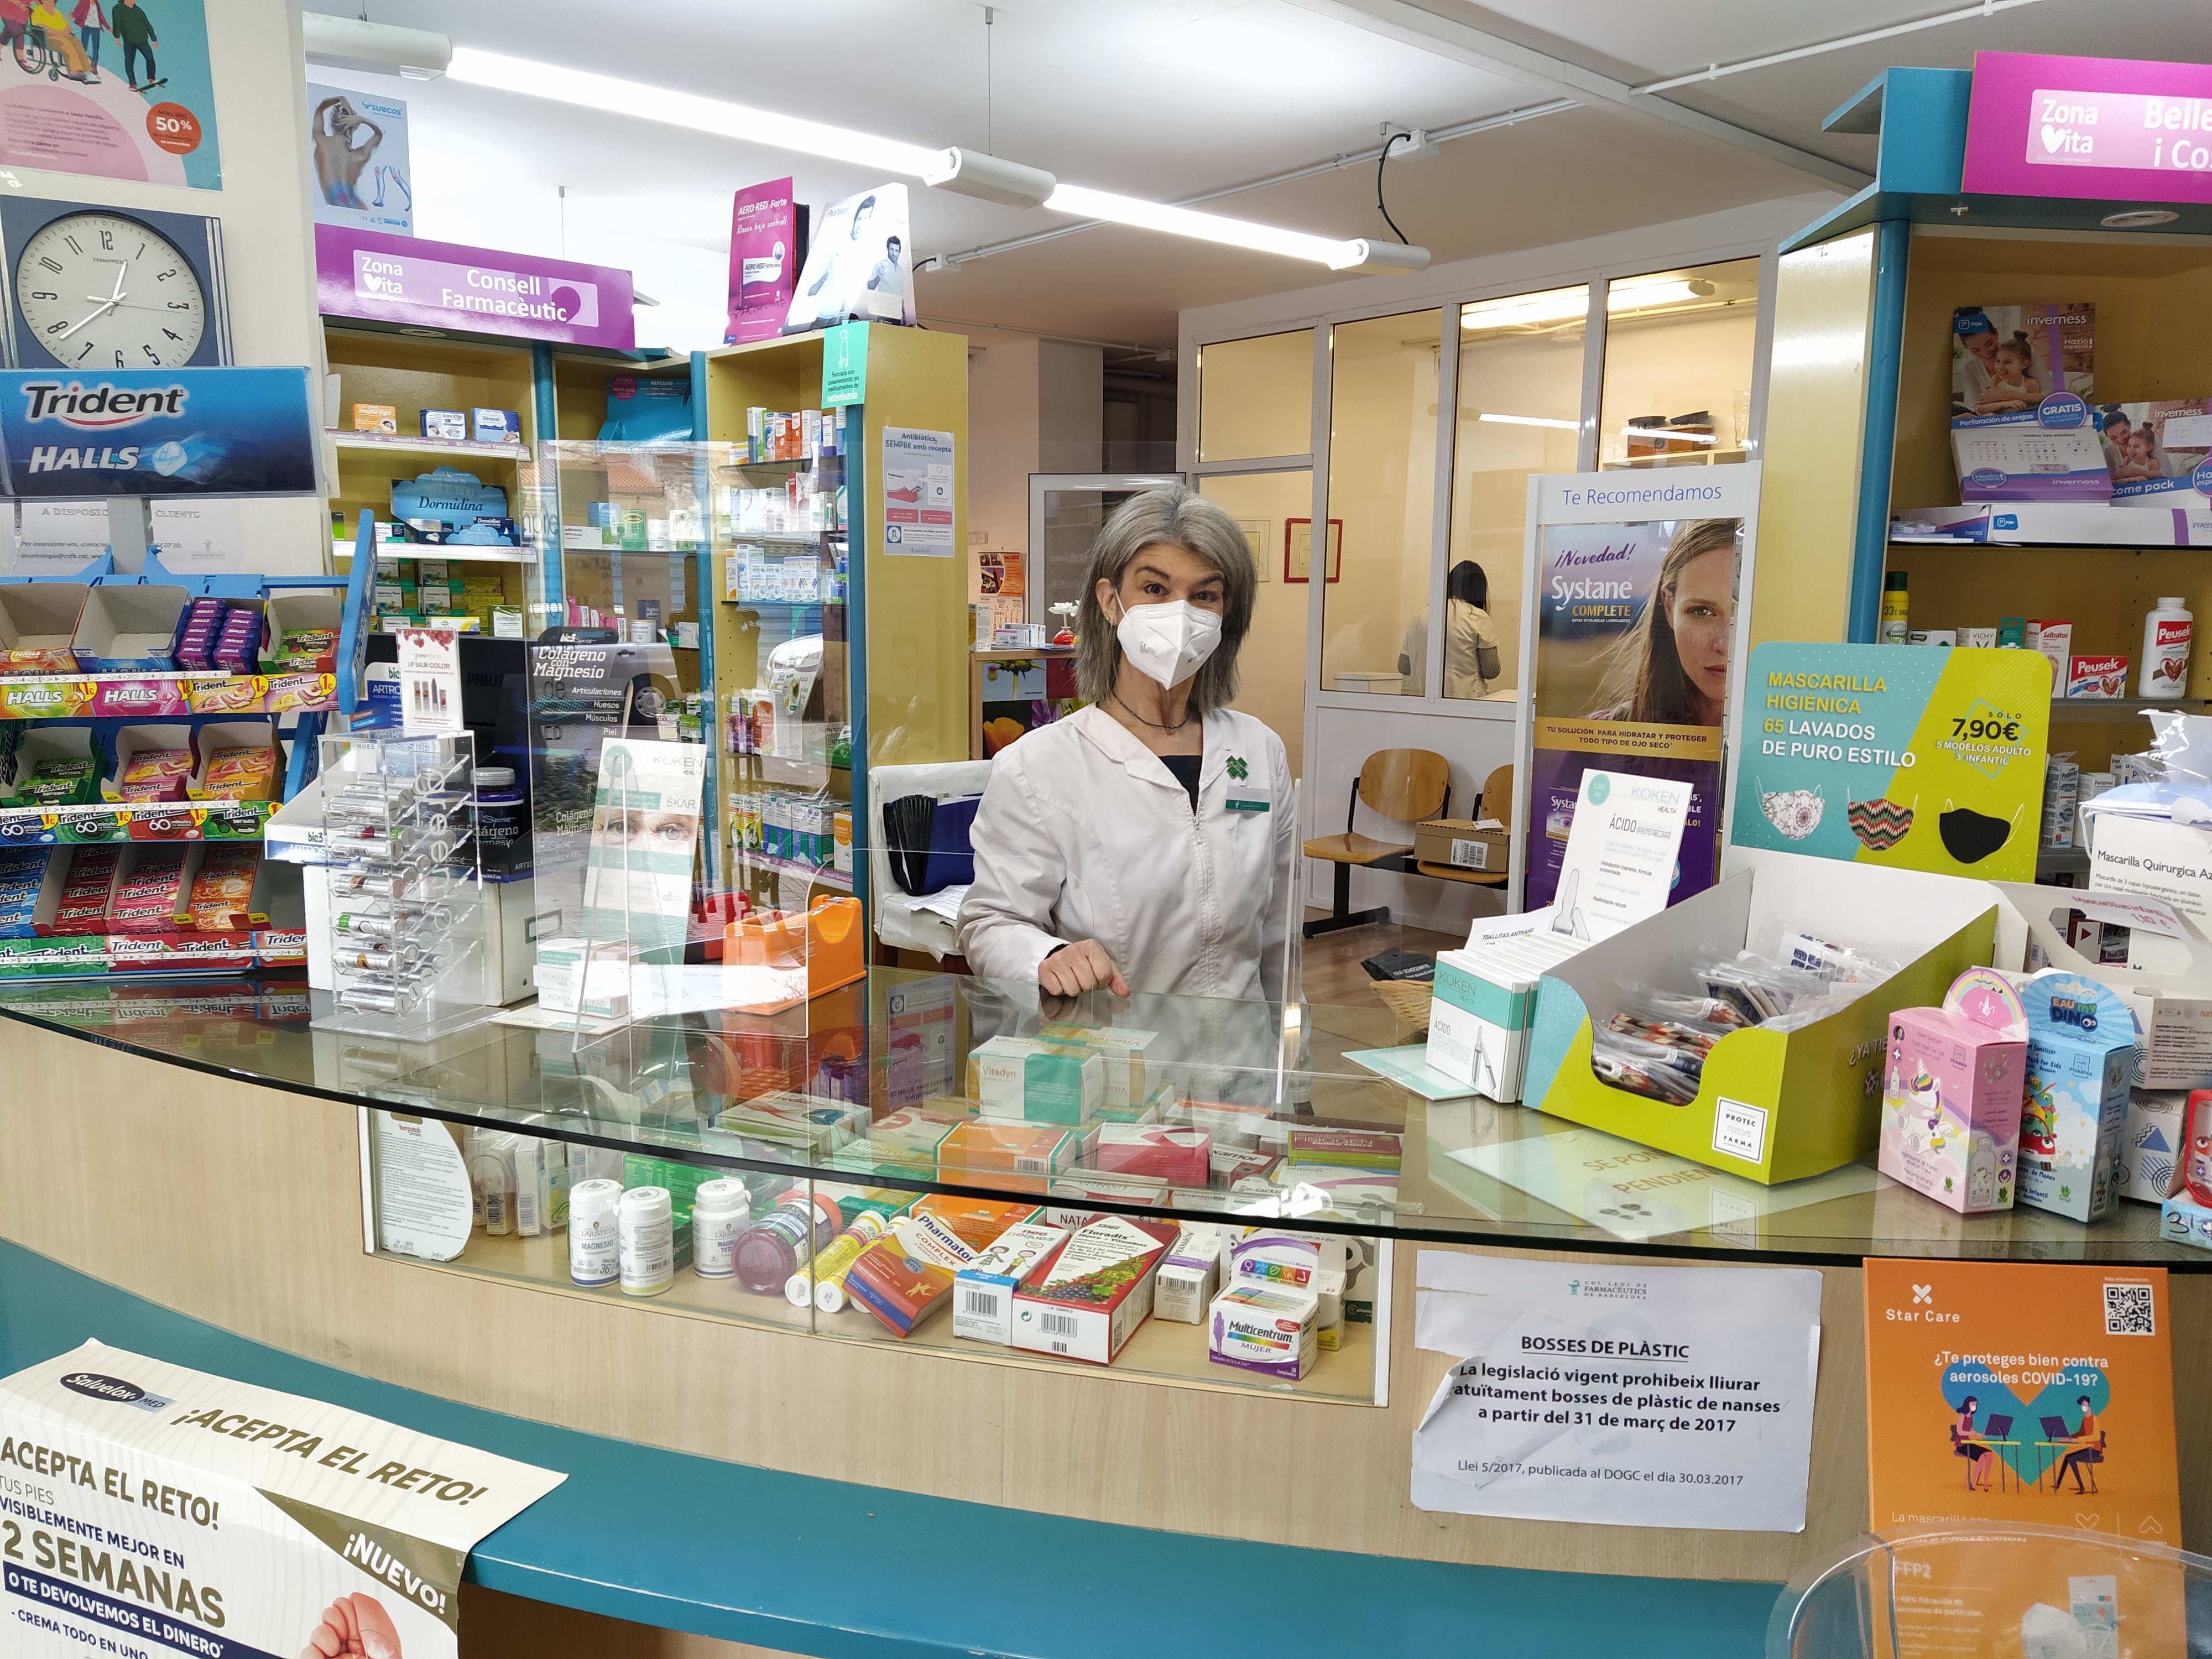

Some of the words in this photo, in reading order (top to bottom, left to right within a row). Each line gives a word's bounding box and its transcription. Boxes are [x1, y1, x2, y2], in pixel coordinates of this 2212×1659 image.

[371, 103, 401, 116] suecos
[2041, 98, 2098, 126] Zona
[155, 117, 192, 132] 50%
[2154, 138, 2162, 167] i
[770, 197, 787, 208] Forte
[754, 221, 765, 233] bajo
[100, 230, 113, 251] 12
[361, 256, 403, 277] Zona
[156, 269, 176, 281] 2
[467, 269, 541, 296] Consell
[442, 288, 567, 322] Farmacèutic
[2027, 314, 2087, 326] inverness
[162, 328, 183, 341] 4
[827, 376, 853, 385] asesoramiento
[827, 383, 851, 392] medicamentos
[25, 385, 184, 418] Trident
[827, 390, 858, 403] veterinaria
[2042, 404, 2082, 415] GRATIS
[2154, 408, 2203, 419] inverness
[1959, 416, 2000, 427] Perforación
[885, 440, 911, 449] SEMPRE
[901, 433, 937, 444] Antibiòtics,
[28, 446, 140, 474] HALLS
[1563, 489, 1581, 505] Te
[1587, 484, 1722, 505] Recomendamos
[418, 496, 483, 512] Dormidina
[155, 510, 200, 518] CLIENTS
[1554, 543, 1636, 568] ¡Novedad!
[1551, 576, 1633, 611] Systane
[1572, 605, 1630, 617] COMPLETE
[2158, 627, 2190, 640] Peusek
[538, 646, 606, 664] Colágeno
[551, 659, 569, 667] con
[2078, 658, 2119, 674] Peusek
[533, 662, 604, 680] Magnesio
[192, 680, 227, 691] Trident
[1769, 672, 1887, 692] MASCARILLA
[6, 690, 63, 706] HALLS
[103, 689, 157, 703] HALLS
[572, 687, 622, 696] Articulaciones
[1767, 693, 1861, 714] HIGIÉNICA
[586, 713, 618, 722] Músculos
[1988, 710, 2021, 719] SÓLO
[1558, 726, 1594, 736] SOLUCIÓN
[1619, 731, 1657, 739] HIDRATAR
[1665, 733, 1707, 743] PROTEGER
[1764, 718, 1785, 734] 65
[1789, 719, 1876, 740] LAVADOS
[1952, 718, 2020, 742] 7,90€
[1632, 739, 1647, 748] OJO
[1944, 742, 1990, 753] MODELOS
[1992, 744, 2031, 756] ADULTO
[1762, 740, 1786, 756] DE
[1791, 742, 1843, 761] PURO
[1848, 748, 1916, 768] ESTILO
[1966, 754, 2008, 765] INFANTIL
[653, 755, 703, 768] KOKEN
[666, 797, 696, 807] SKAR
[1631, 786, 1680, 804] KOKEN
[75, 821, 97, 833] 60
[307, 832, 324, 843] bie3
[2098, 850, 2140, 867] Mascarilla
[2143, 859, 2196, 878] Quirurgica
[1483, 931, 1509, 941] TOALLITAS
[111, 940, 164, 952] Trident
[2053, 998, 2075, 1009] EAU
[982, 1066, 1016, 1078] Vitadyn
[2069, 1067, 2093, 1077] PHARMA
[1294, 1135, 1373, 1146] FISIOGEN
[582, 1227, 615, 1237] LAJUSTICIA
[1006, 1231, 1055, 1242] peques
[1081, 1228, 1131, 1240] Floradix
[581, 1240, 613, 1250] MAGNESIO
[599, 1262, 610, 1275] 36
[1584, 1285, 1647, 1295] FARMACÈUTICS
[1886, 1308, 1919, 1323] Star
[1925, 1310, 1960, 1323] Care
[1229, 1320, 1292, 1343] Multicentrum
[1241, 1343, 1271, 1354] MUJER
[1521, 1336, 1587, 1353] BOSSES
[1591, 1340, 1614, 1355] DE
[1619, 1339, 1690, 1359] PLÀSTIC
[1934, 1352, 1959, 1367] ¿Te
[1963, 1353, 2026, 1368] proteges
[2028, 1354, 2059, 1366] bien
[2063, 1356, 2109, 1368] contra
[1459, 1363, 1477, 1377] La
[1481, 1363, 1561, 1384] legislació
[1564, 1369, 1619, 1387] vigent
[1623, 1371, 1705, 1389] prohibeix
[1709, 1375, 1761, 1391] lliurar
[1949, 1370, 2018, 1384] aerosoles
[2022, 1371, 2098, 1386] COVID-19?
[67, 1373, 132, 1401] Salvelox
[139, 1396, 165, 1410] MED
[1552, 1388, 1609, 1405] bosses
[1612, 1391, 1633, 1407] de
[1637, 1393, 1693, 1411] plàstic
[1697, 1396, 1718, 1411] de
[1722, 1399, 1781, 1413] nanses
[1478, 1409, 1488, 1420] a
[1492, 1407, 1540, 1424] partir
[1544, 1409, 1570, 1425] del
[1573, 1411, 1593, 1426] 31
[1598, 1412, 1619, 1427] de
[1624, 1415, 1665, 1433] març
[1669, 1416, 1690, 1431] de
[1694, 1418, 1736, 1433] 2017
[169, 1408, 321, 1459] ¡ACEPTA
[317, 1444, 369, 1475] EL
[366, 1459, 489, 1506] RETO!
[1458, 1460, 1479, 1472] Llei
[1481, 1462, 1525, 1475] 5/2017,
[1528, 1464, 1587, 1479] publicada
[1590, 1467, 1601, 1480] al
[1604, 1469, 1641, 1481] DOGC
[1644, 1470, 1654, 1481] el
[1657, 1470, 1676, 1483] dia
[1678, 1472, 1743, 1486] 30.03.2017
[25, 1483, 54, 1506] PIES
[104, 1467, 135, 1504] EL
[141, 1479, 219, 1531] RETO!
[0, 1496, 103, 1543] VISIBLEMENTE
[107, 1530, 160, 1561] MEJOR
[163, 1549, 185, 1569] EN
[2, 1519, 24, 1561] 2
[32, 1529, 226, 1629] SEMANAS
[343, 1533, 447, 1615] ¡NUEVO!
[8, 1572, 19, 1587] O
[20, 1575, 38, 1594] TE
[40, 1581, 140, 1629] DEVOLVEMOS
[142, 1616, 161, 1637] EL
[18, 1608, 61, 1634] CREMA
[62, 1624, 97, 1646] TODO
[99, 1637, 117, 1653] EN
[119, 1644, 148, 1659] UNO
